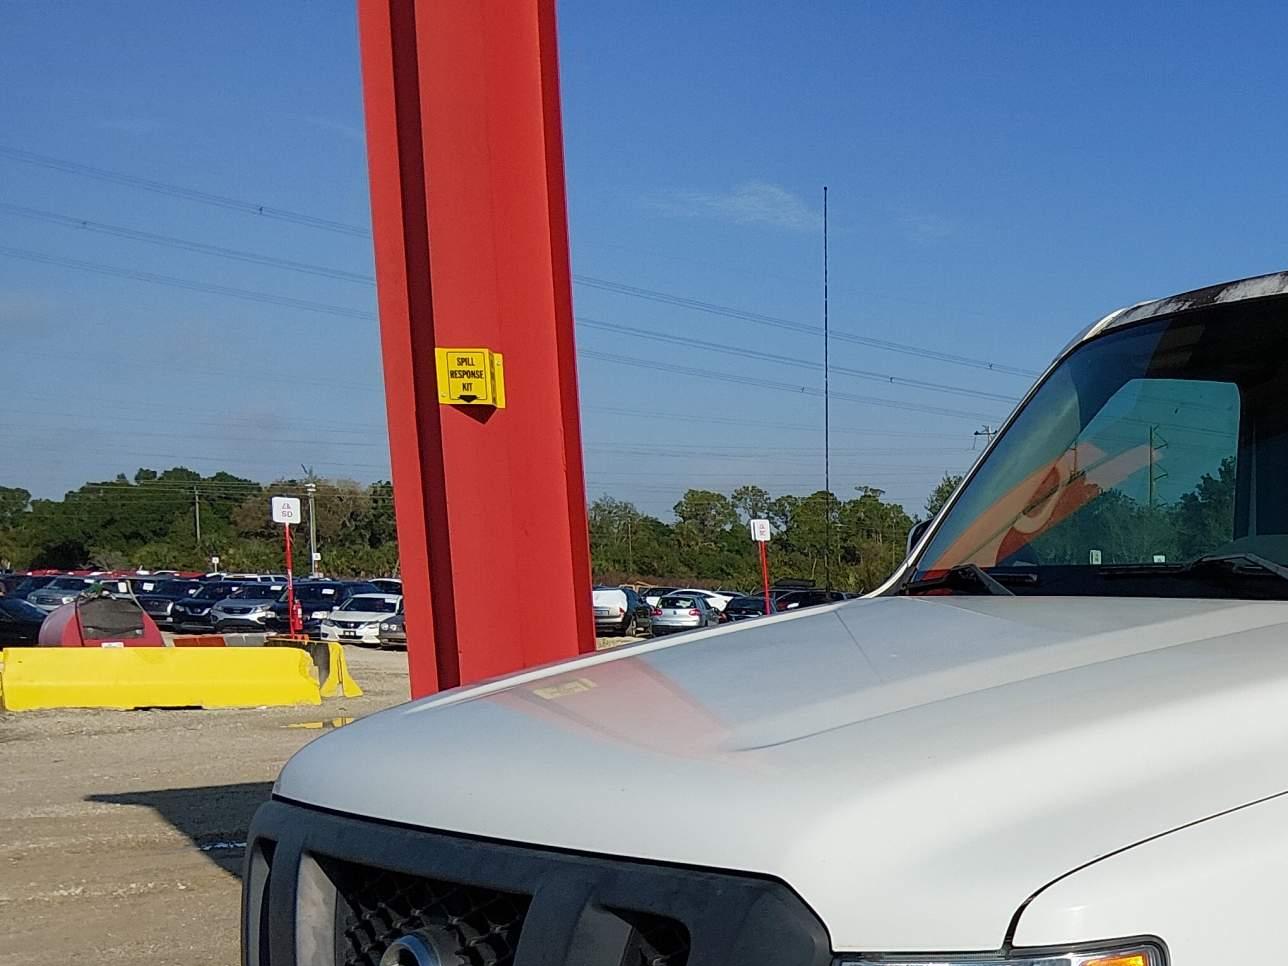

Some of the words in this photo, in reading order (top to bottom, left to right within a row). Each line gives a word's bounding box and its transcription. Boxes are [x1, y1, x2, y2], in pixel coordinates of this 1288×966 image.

[457, 357, 475, 366] SPILL
[450, 370, 484, 379] RESPONSE
[462, 382, 473, 392] KIT
